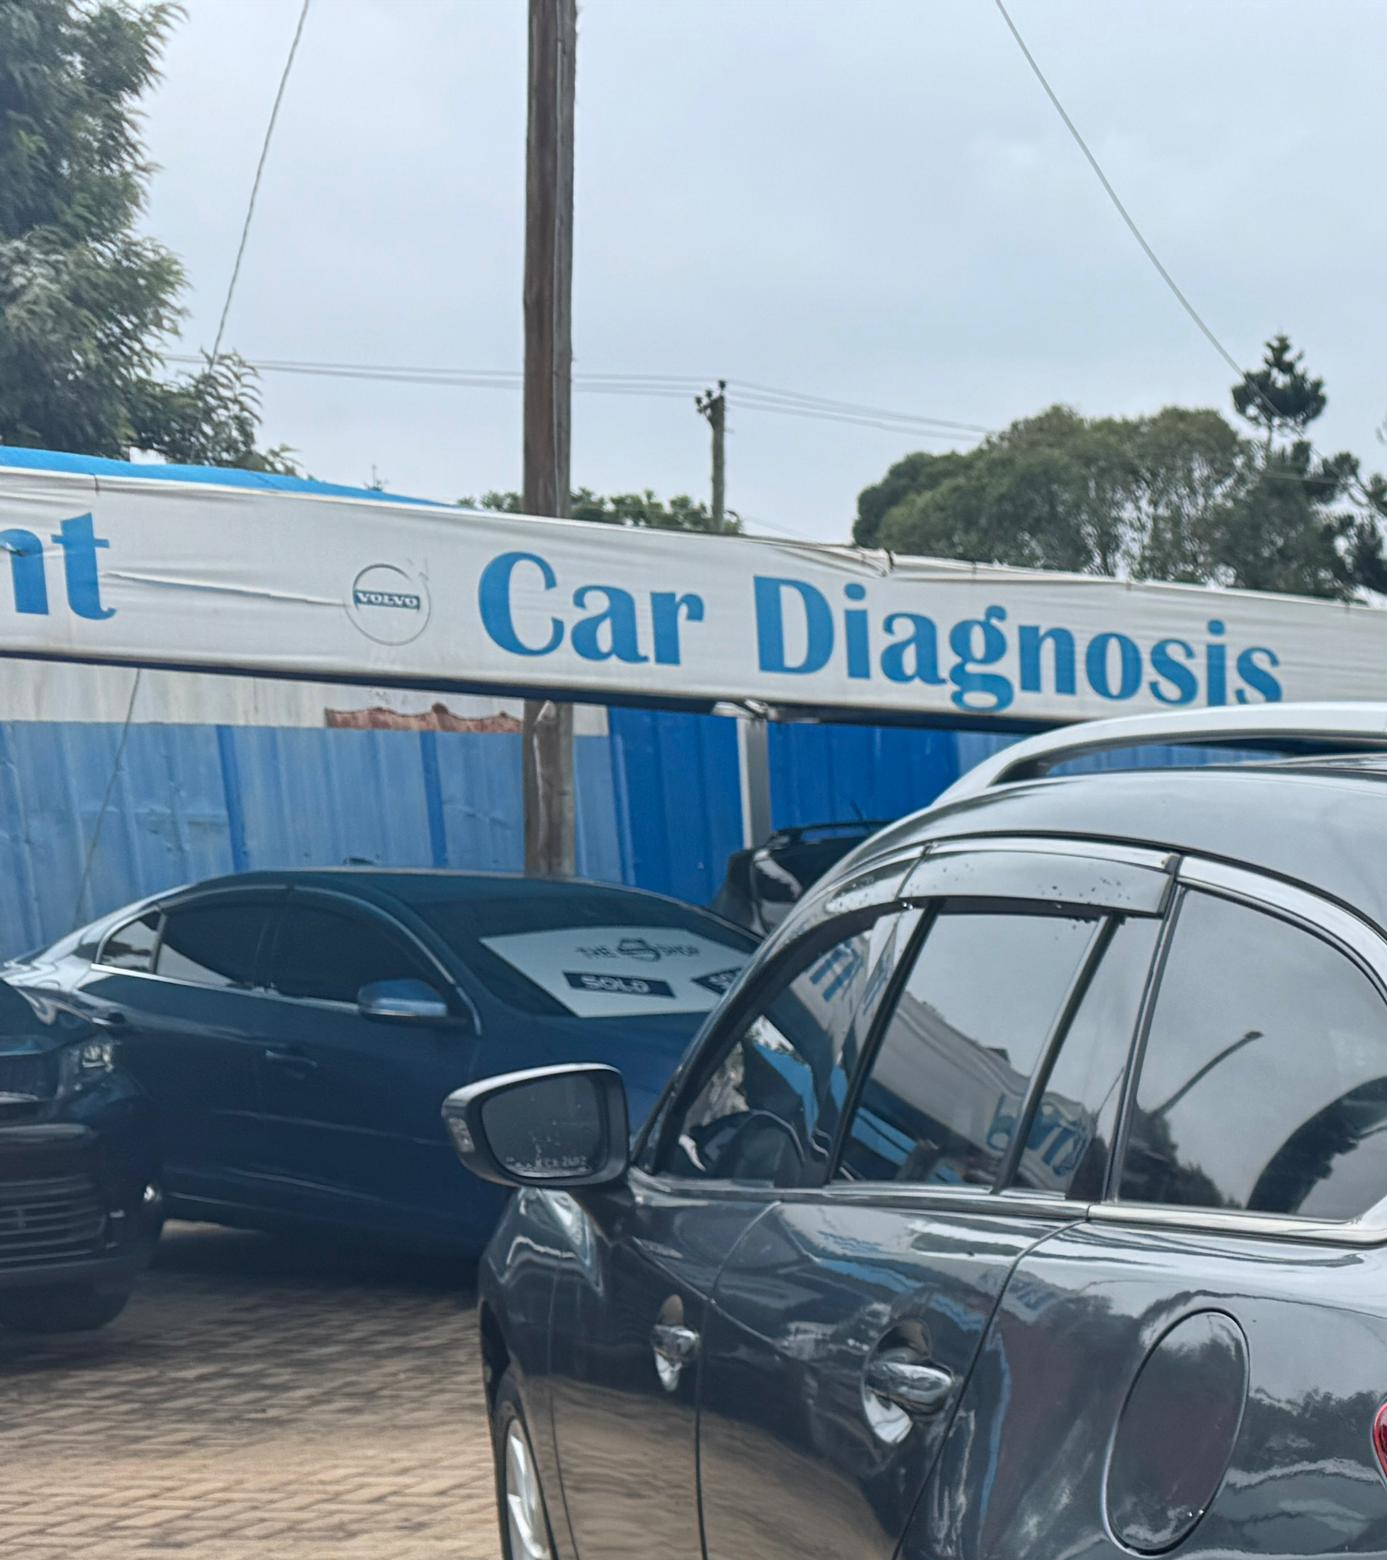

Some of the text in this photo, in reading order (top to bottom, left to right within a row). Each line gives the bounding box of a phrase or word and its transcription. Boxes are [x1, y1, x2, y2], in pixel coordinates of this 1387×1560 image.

[356, 592, 418, 606] VOLVO
[478, 551, 1283, 713] Car Diagnosis
[581, 976, 650, 994] SOLD
